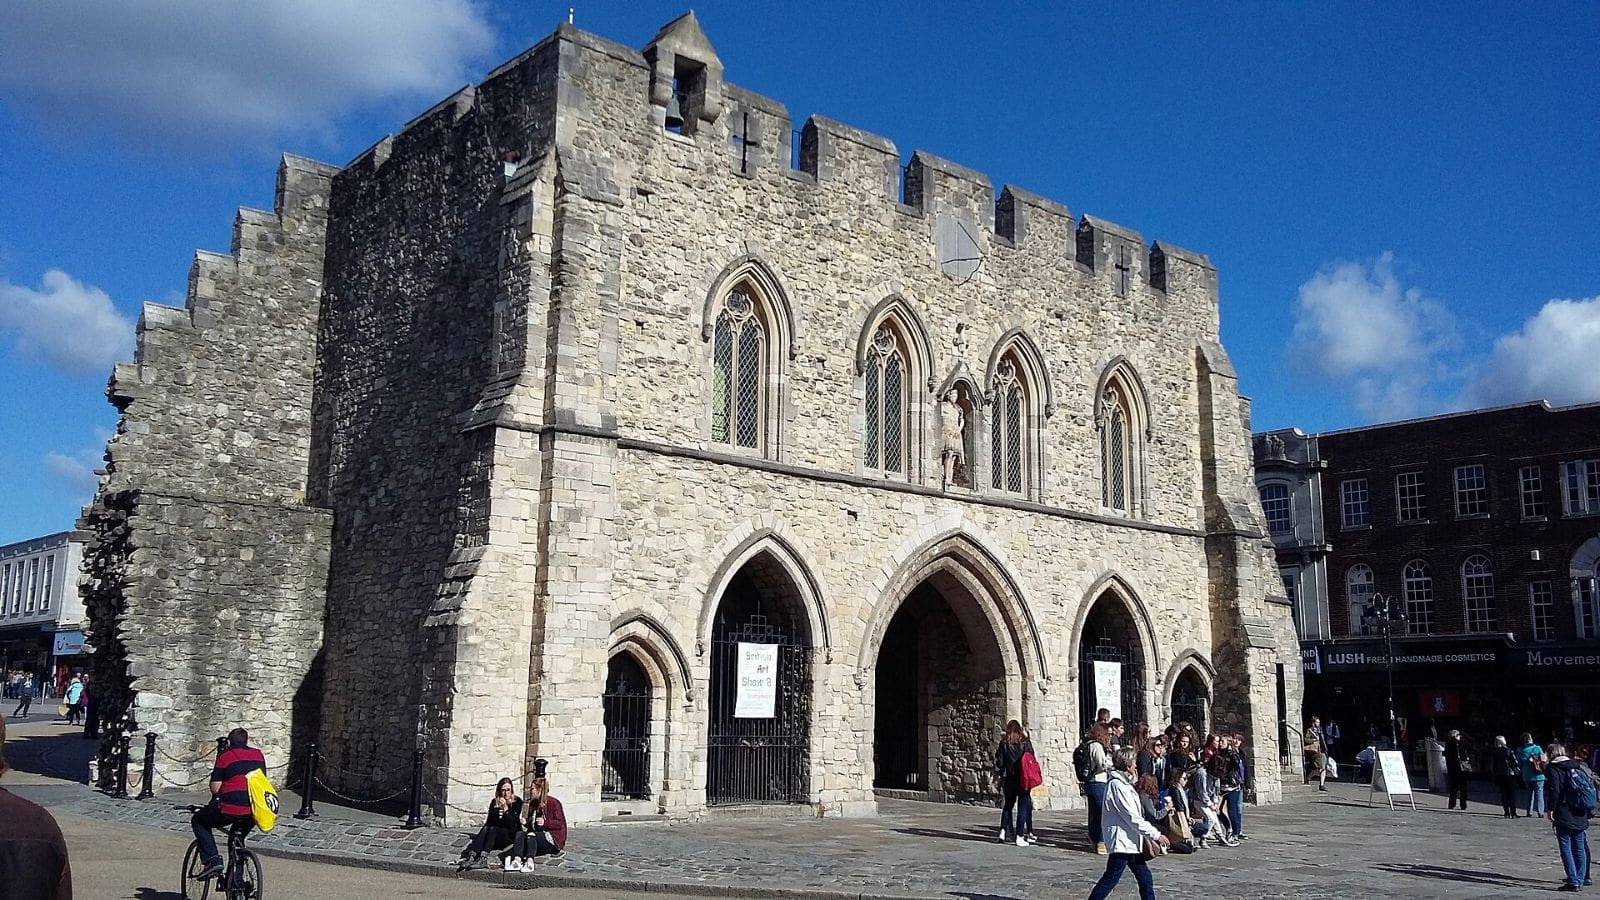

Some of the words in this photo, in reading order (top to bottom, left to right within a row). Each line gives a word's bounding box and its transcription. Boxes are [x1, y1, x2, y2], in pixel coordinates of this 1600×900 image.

[1328, 653, 1365, 664] LUSH
[1395, 655, 1443, 663] HANDMADE
[1444, 653, 1496, 662] COSMETICS
